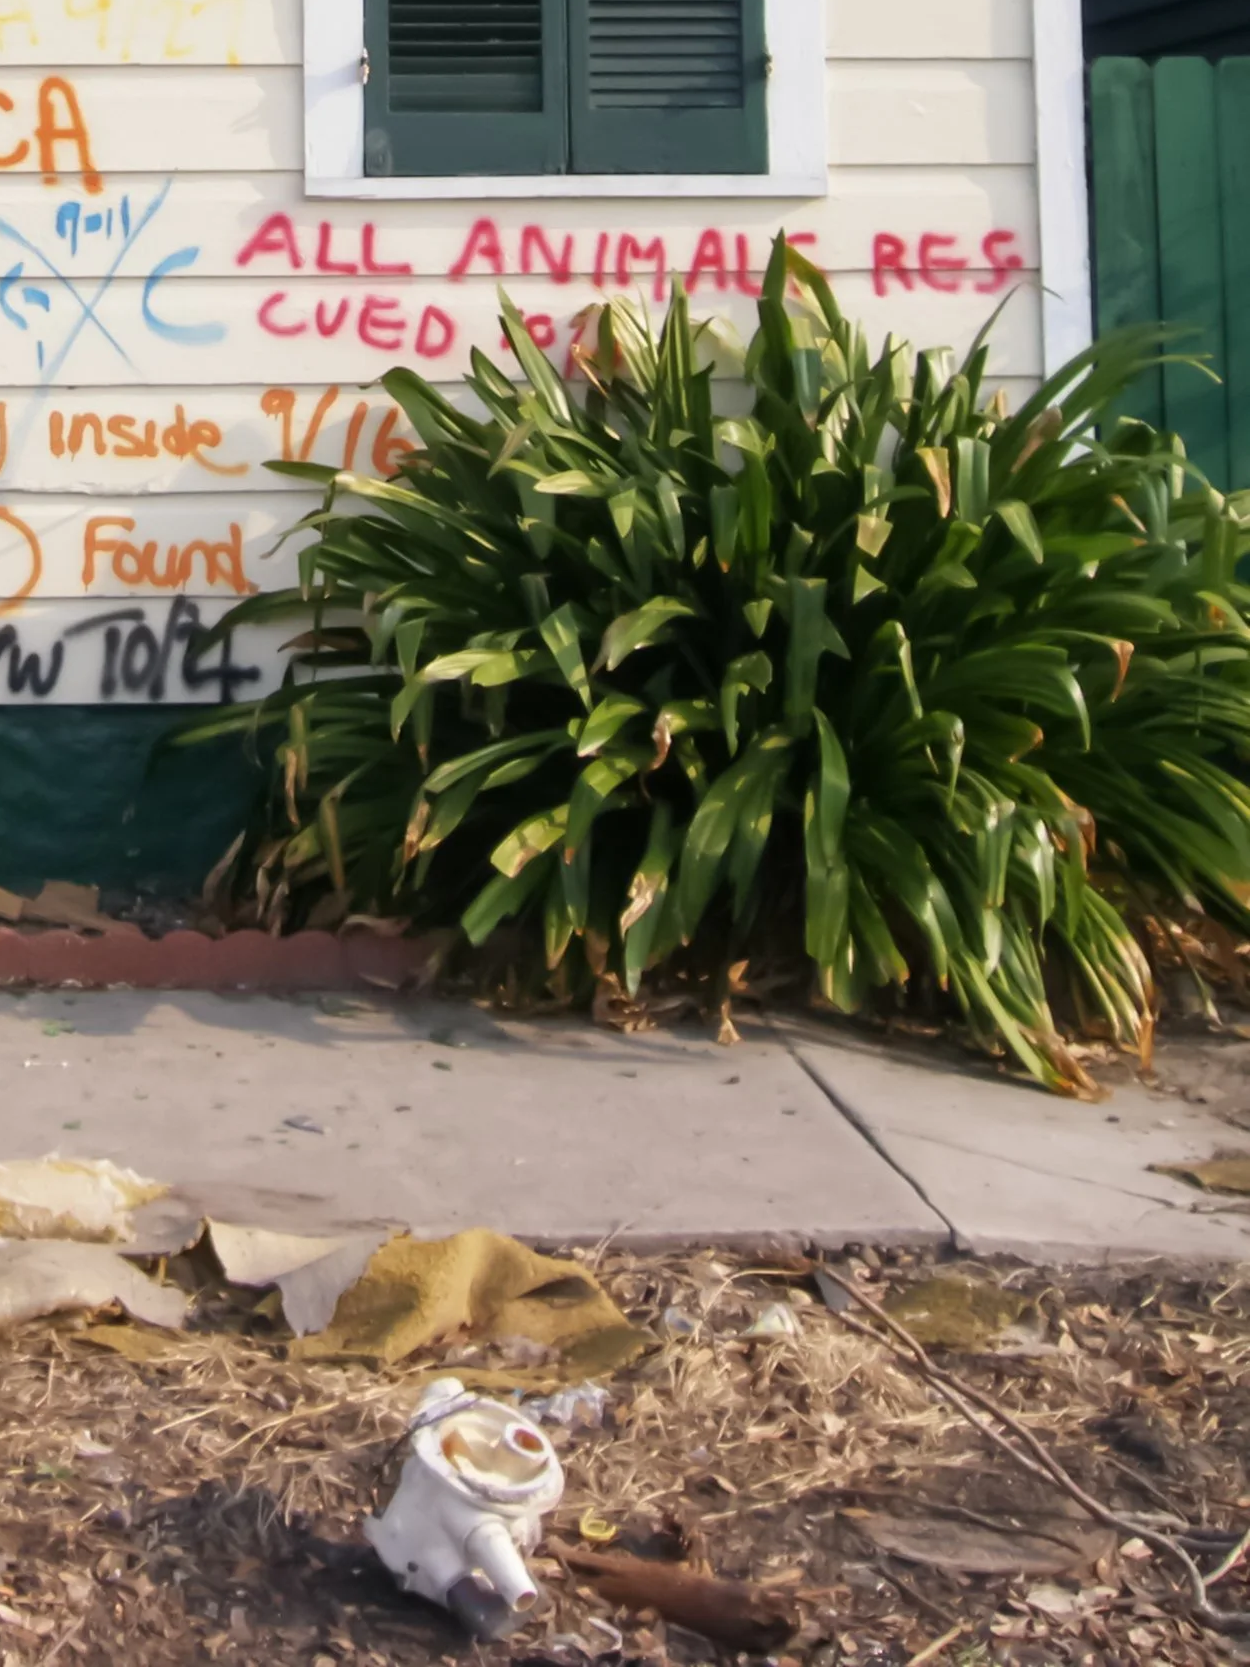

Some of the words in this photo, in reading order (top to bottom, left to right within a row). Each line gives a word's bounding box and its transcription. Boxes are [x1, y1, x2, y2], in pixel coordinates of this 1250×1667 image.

[235, 211, 413, 277] ALL
[256, 291, 458, 360] CUED
[80, 516, 261, 596] Found
